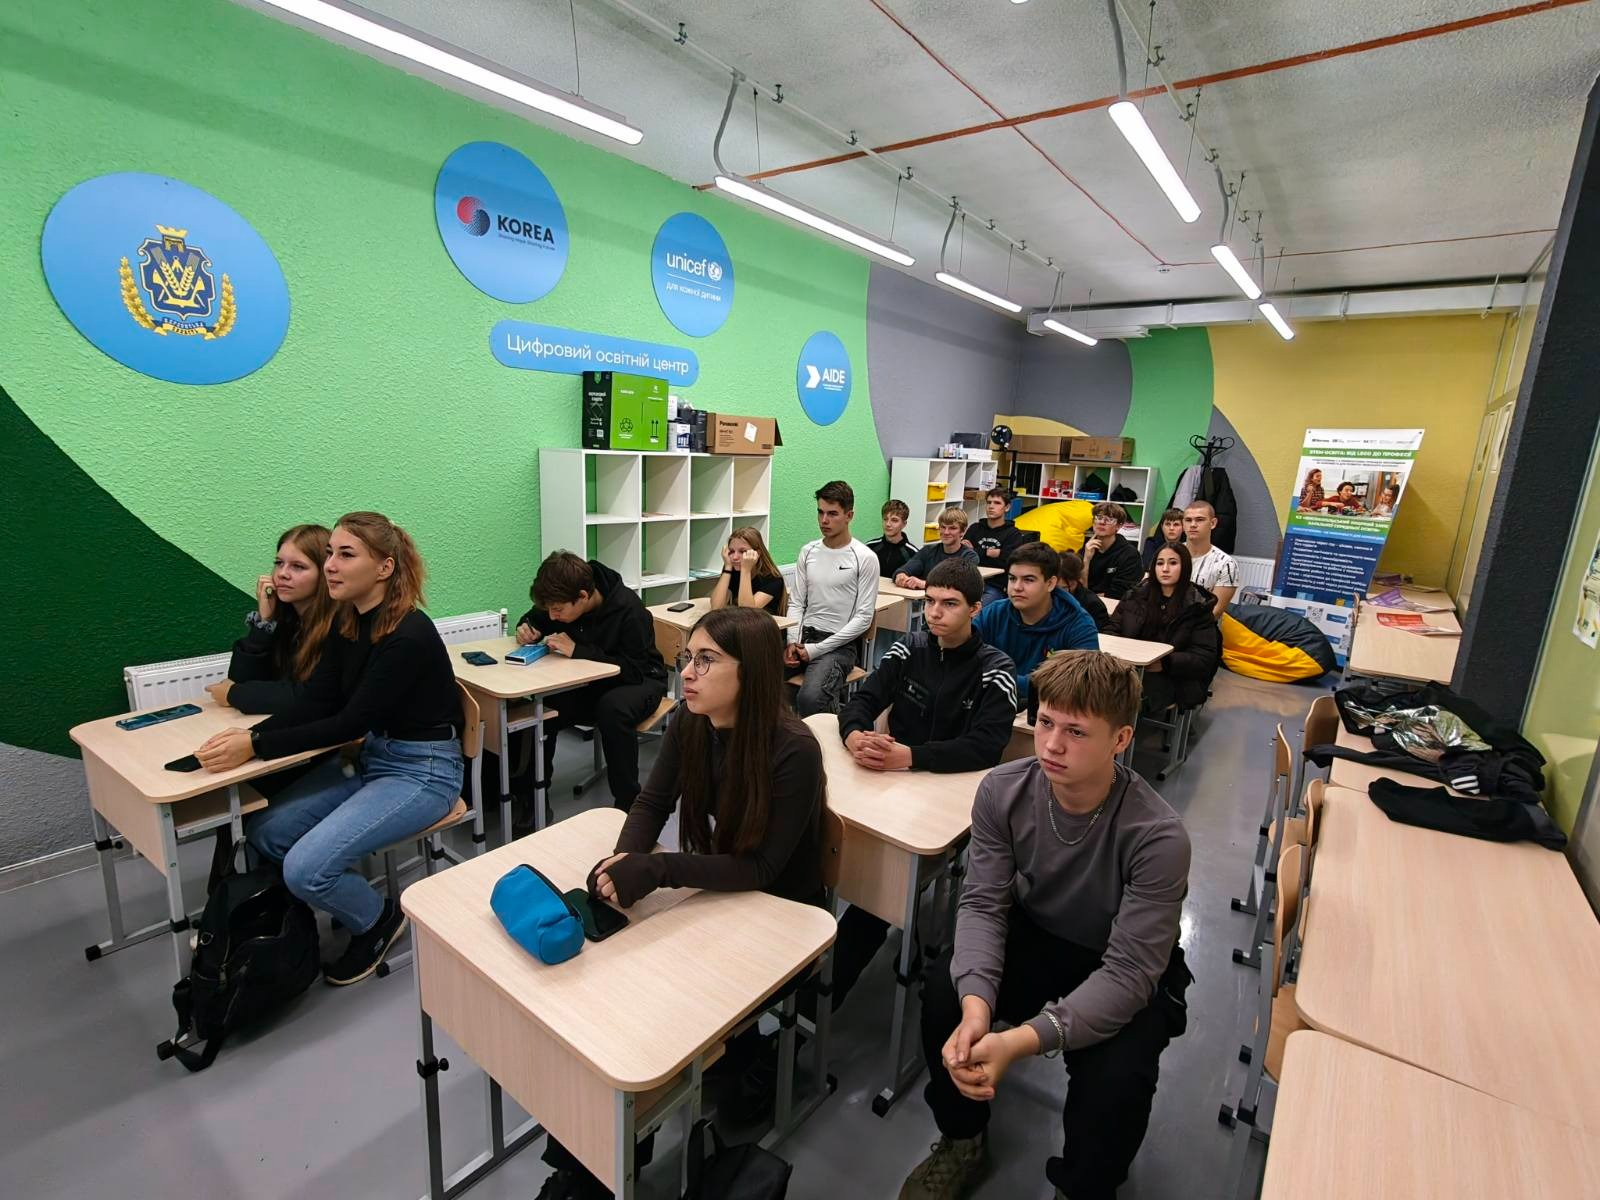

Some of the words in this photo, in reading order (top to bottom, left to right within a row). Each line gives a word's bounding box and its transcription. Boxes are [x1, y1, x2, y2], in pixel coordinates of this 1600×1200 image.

[497, 214, 555, 244] KOREA
[666, 252, 707, 277] unicef
[507, 333, 592, 361] Цифровий
[595, 350, 650, 368] освітній
[653, 360, 689, 375] центр
[822, 367, 846, 384] AIDE
